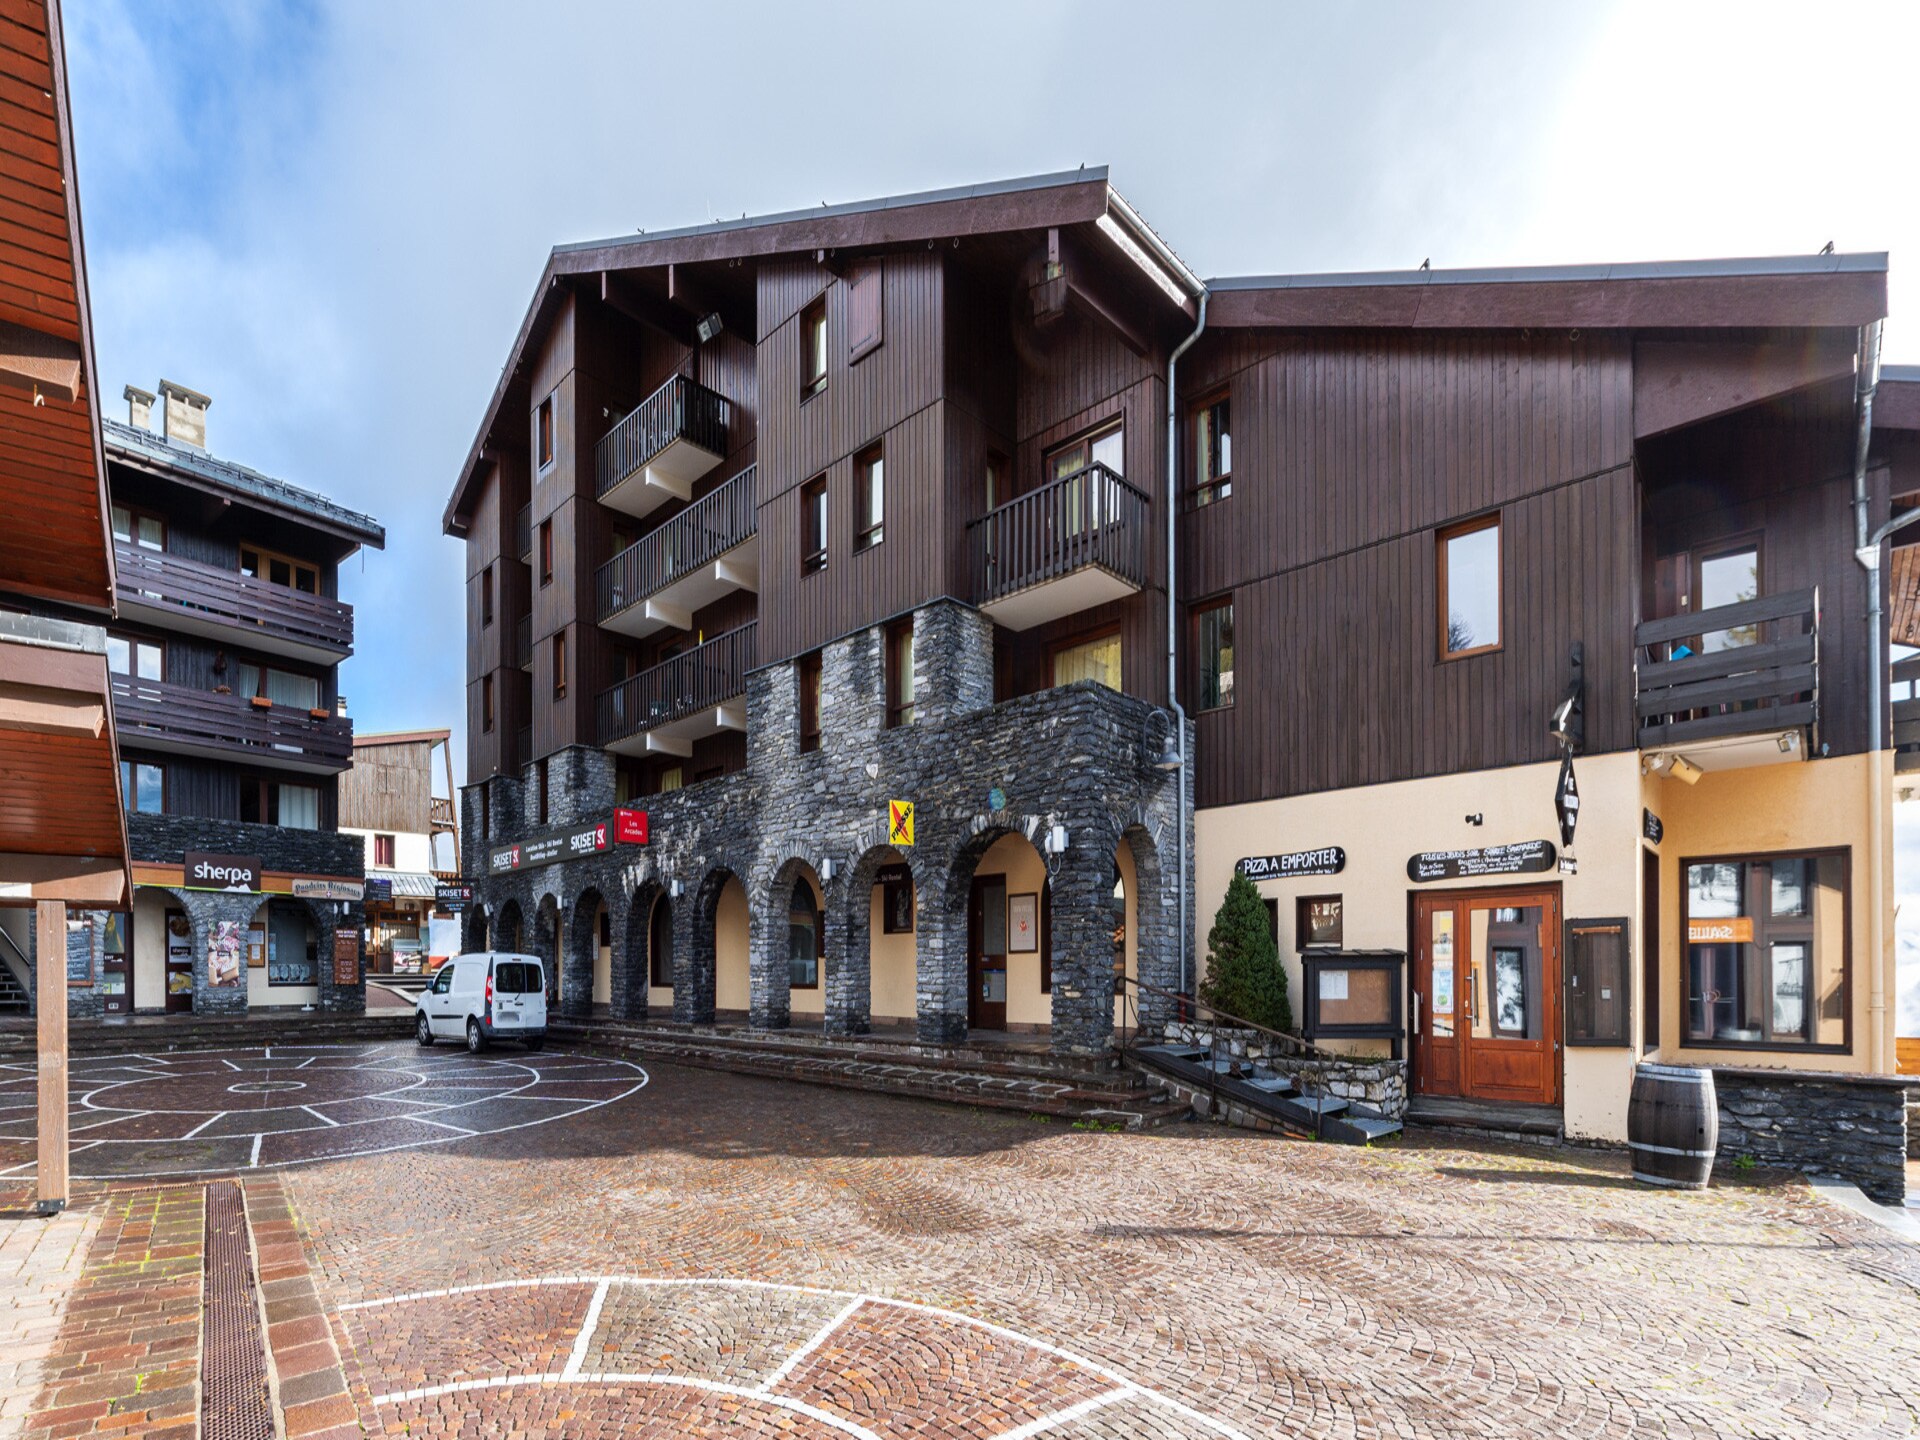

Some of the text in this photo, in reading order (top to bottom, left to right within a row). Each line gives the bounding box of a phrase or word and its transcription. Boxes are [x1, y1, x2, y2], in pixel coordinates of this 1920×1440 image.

[891, 804, 913, 841] PRESSE
[570, 831, 597, 851] SKISET
[493, 851, 513, 868] SKISET
[1281, 848, 1338, 870] EMPORTER
[194, 861, 252, 884] sherpa
[438, 888, 462, 897] SKISET
